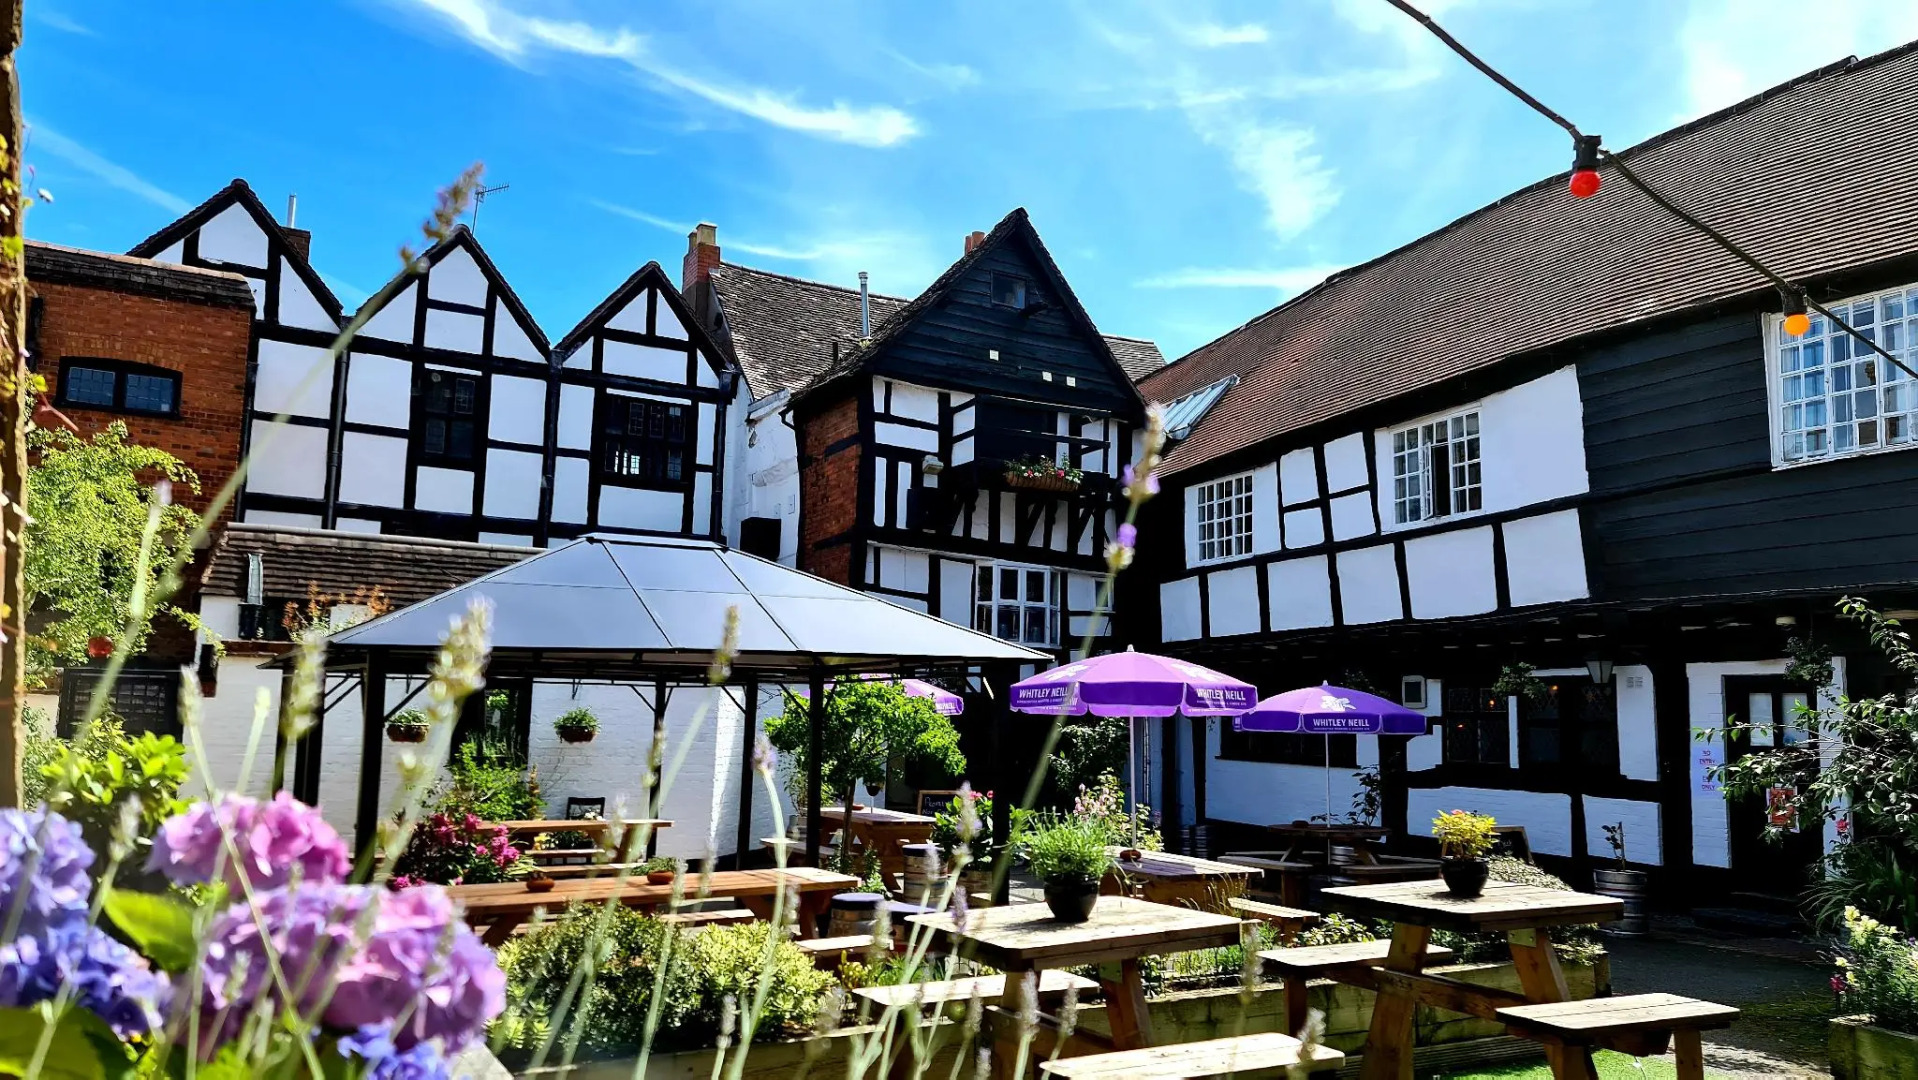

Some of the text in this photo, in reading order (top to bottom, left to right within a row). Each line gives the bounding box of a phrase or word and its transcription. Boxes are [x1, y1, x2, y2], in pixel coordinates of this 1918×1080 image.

[1019, 688, 1051, 698] WHITLEY
[1196, 688, 1246, 701] WHITLEY NEILL
[1313, 718, 1370, 727] WHITLEY NEILL
